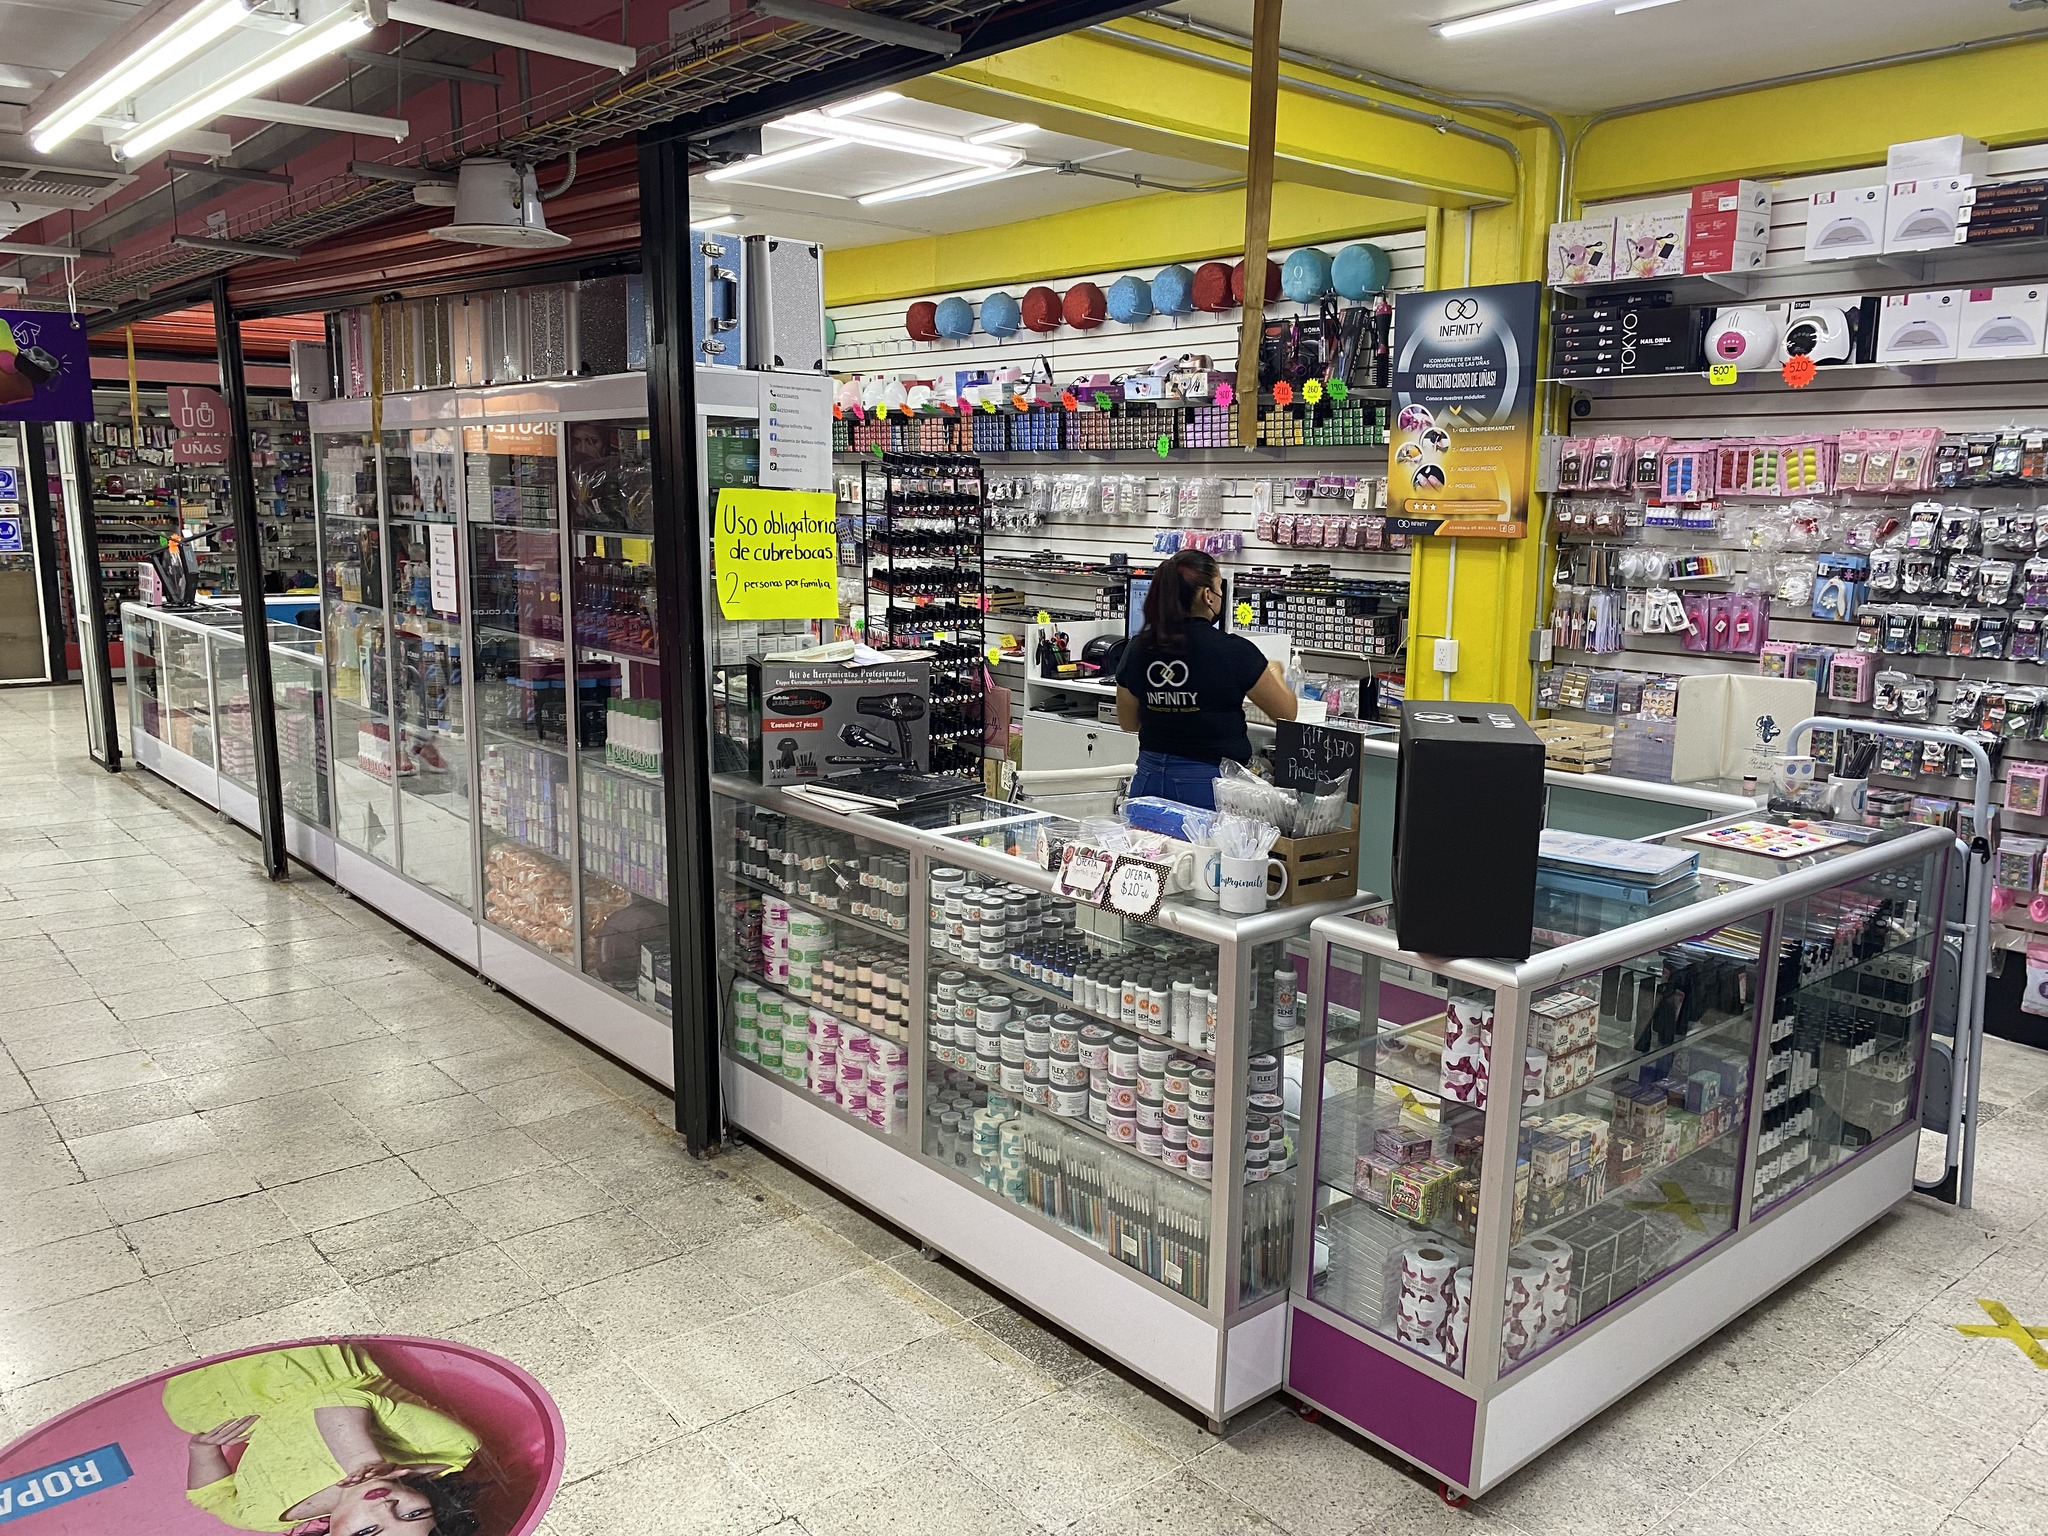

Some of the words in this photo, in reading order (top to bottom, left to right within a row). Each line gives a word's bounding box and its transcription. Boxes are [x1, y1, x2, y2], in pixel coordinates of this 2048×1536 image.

[2024, 204, 2039, 212] NAIL
[1440, 322, 1483, 337] INFINITY
[1621, 314, 1638, 373] TOKYO
[1416, 374, 1427, 388] CON
[1428, 373, 1451, 389] NUESTRO
[1452, 372, 1470, 389] CURSO
[1471, 372, 1478, 388] DE
[1479, 369, 1497, 386] UÑAS!
[182, 440, 222, 454] UÑAS
[724, 504, 758, 535] Uso
[764, 510, 837, 541] obligatorio
[730, 538, 750, 560] de
[725, 572, 740, 604] 2
[744, 580, 782, 592] personas
[785, 579, 798, 589] por
[789, 670, 800, 679] Kit
[802, 670, 811, 679] de
[812, 669, 858, 679] Herramientas
[860, 669, 906, 679] Profesionales
[1147, 692, 1198, 706] INFINITY
[770, 721, 795, 729] Contenido
[1323, 735, 1355, 763] $170
[1287, 757, 1331, 784] Pinceles
[1076, 857, 1098, 869] OFERTA
[1125, 868, 1153, 881] OFERTA
[1080, 1048, 1092, 1058] FLEX
[1052, 1066, 1064, 1075] FLEX
[1024, 1085, 1034, 1093] FLEX
[1193, 1113, 1205, 1121] FLEX
[1394, 1192, 1419, 1211] Jelly
